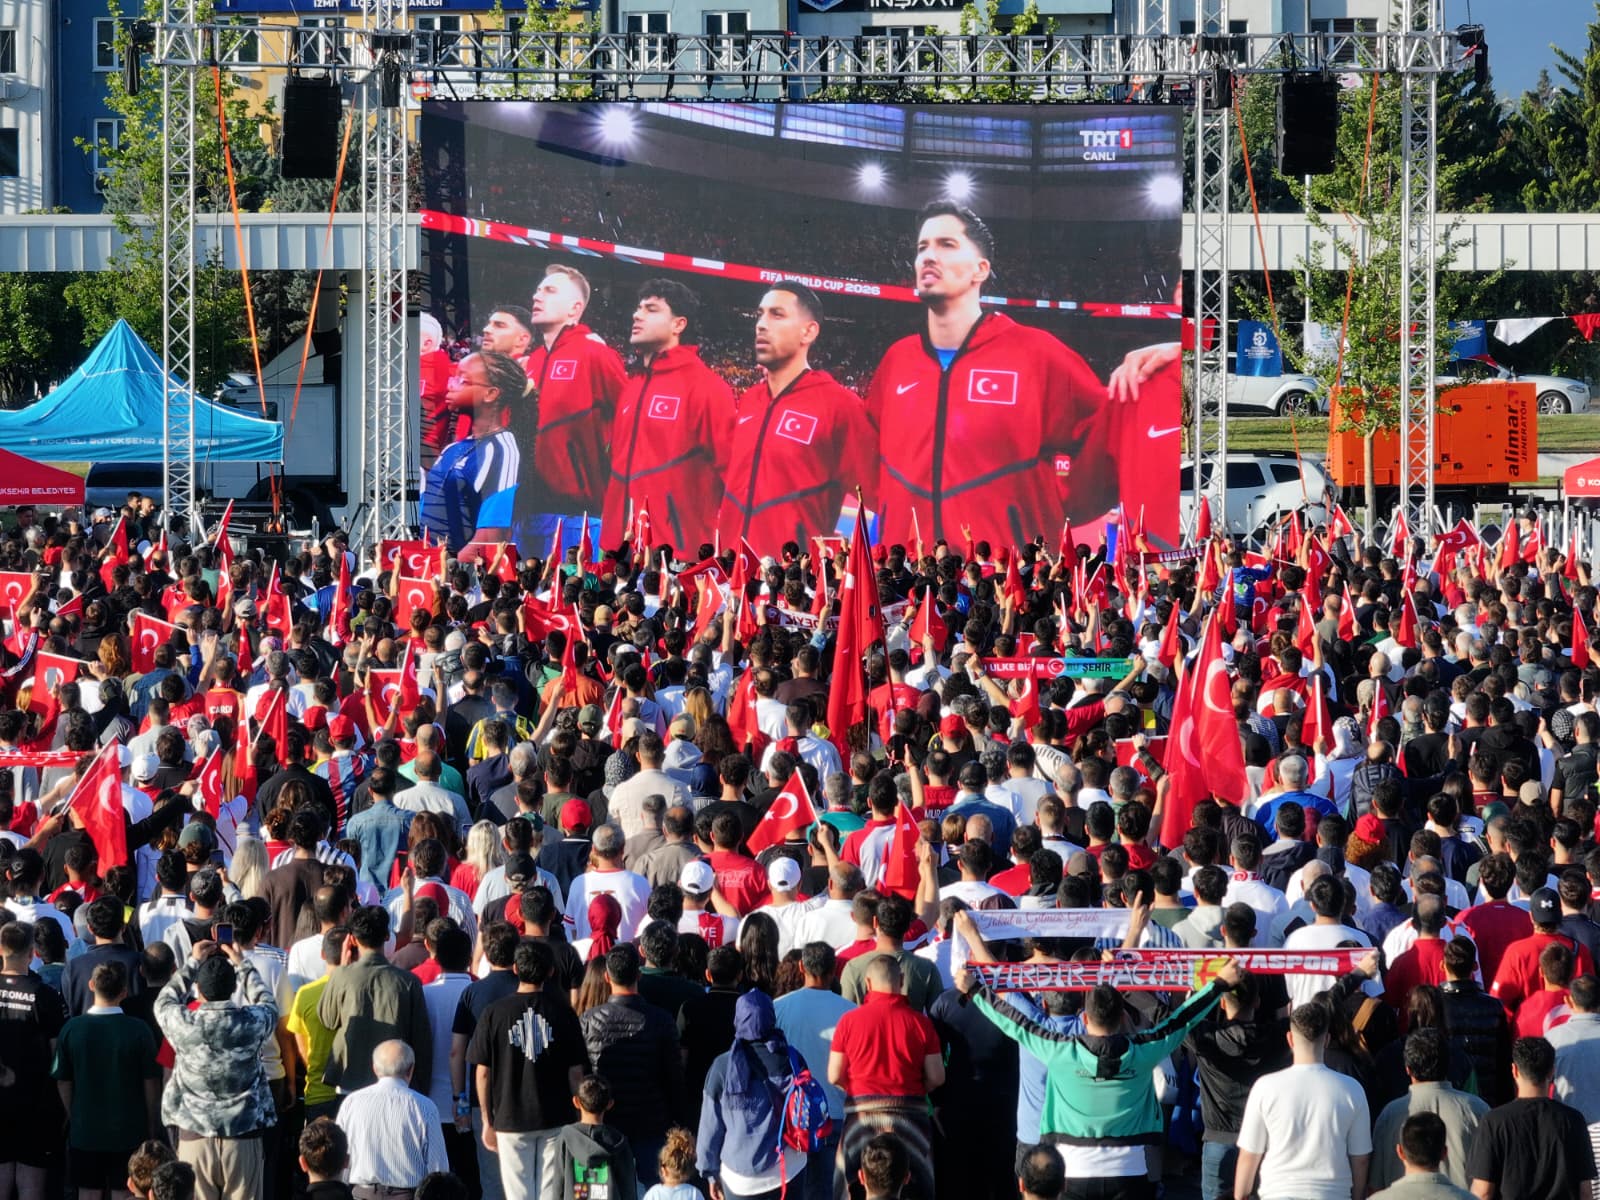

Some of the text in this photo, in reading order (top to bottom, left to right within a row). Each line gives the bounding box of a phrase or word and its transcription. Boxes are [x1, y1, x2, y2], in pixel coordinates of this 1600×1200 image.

[1083, 152, 1116, 160] CANLI
[760, 270, 880, 296] FIFA WORLD CUP 2026
[1504, 404, 1520, 477] alimar
